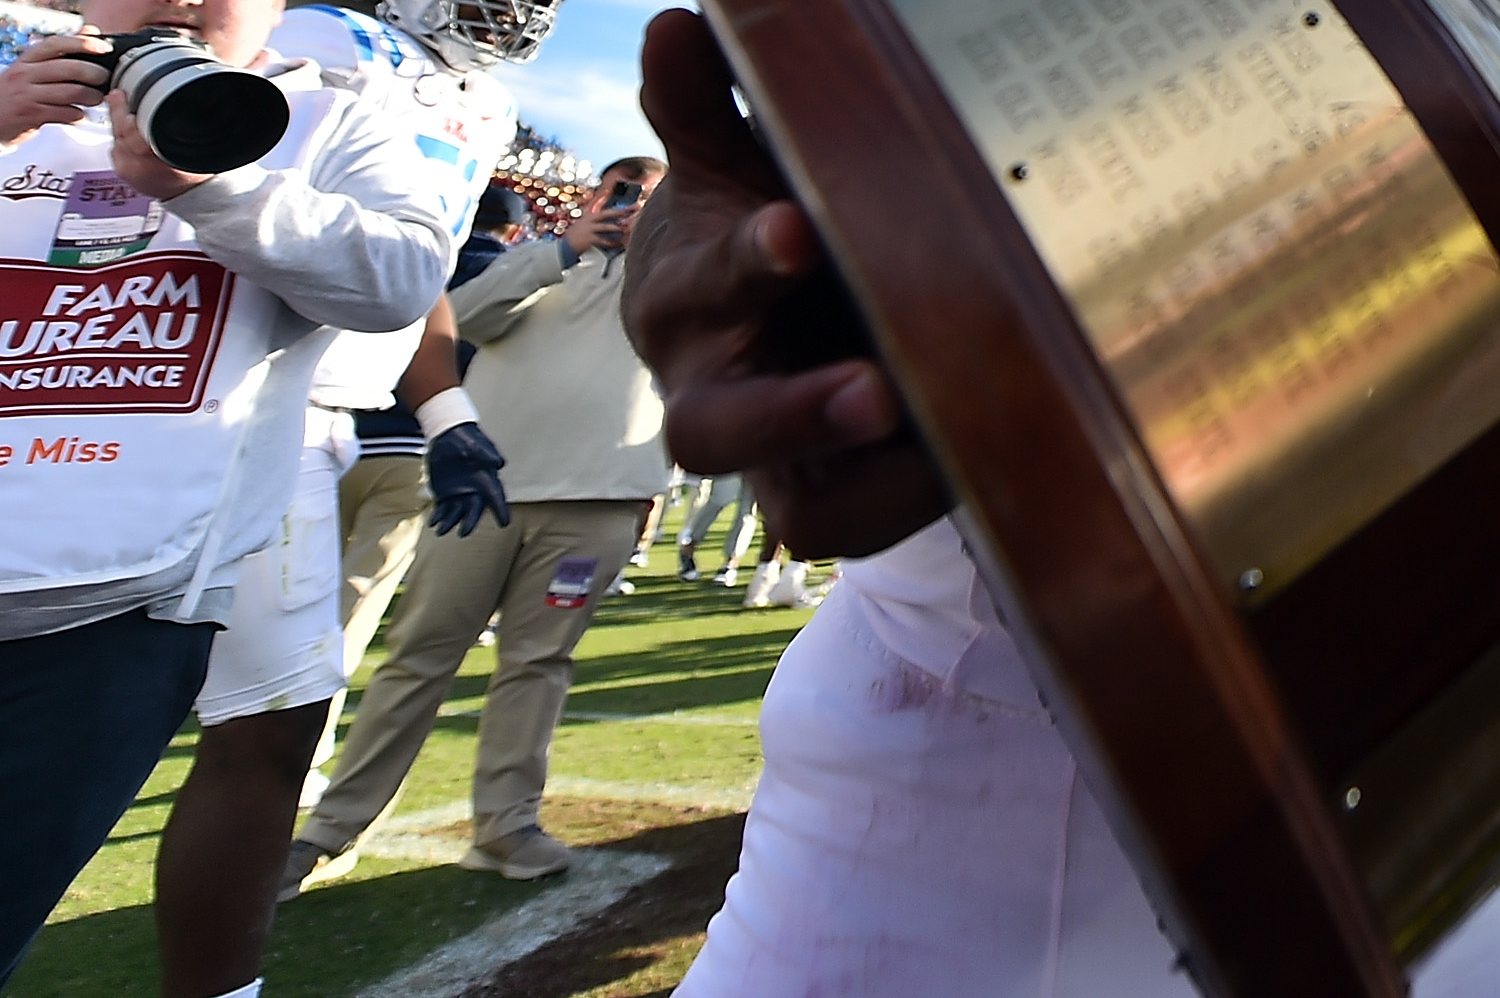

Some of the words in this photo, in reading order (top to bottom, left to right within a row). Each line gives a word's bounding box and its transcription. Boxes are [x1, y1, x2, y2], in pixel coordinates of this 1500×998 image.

[1, 164, 74, 194] Sta
[79, 185, 136, 202] STA
[79, 248, 125, 264] MEDIA
[42, 271, 200, 317] FARM
[25, 436, 120, 465] Miss
